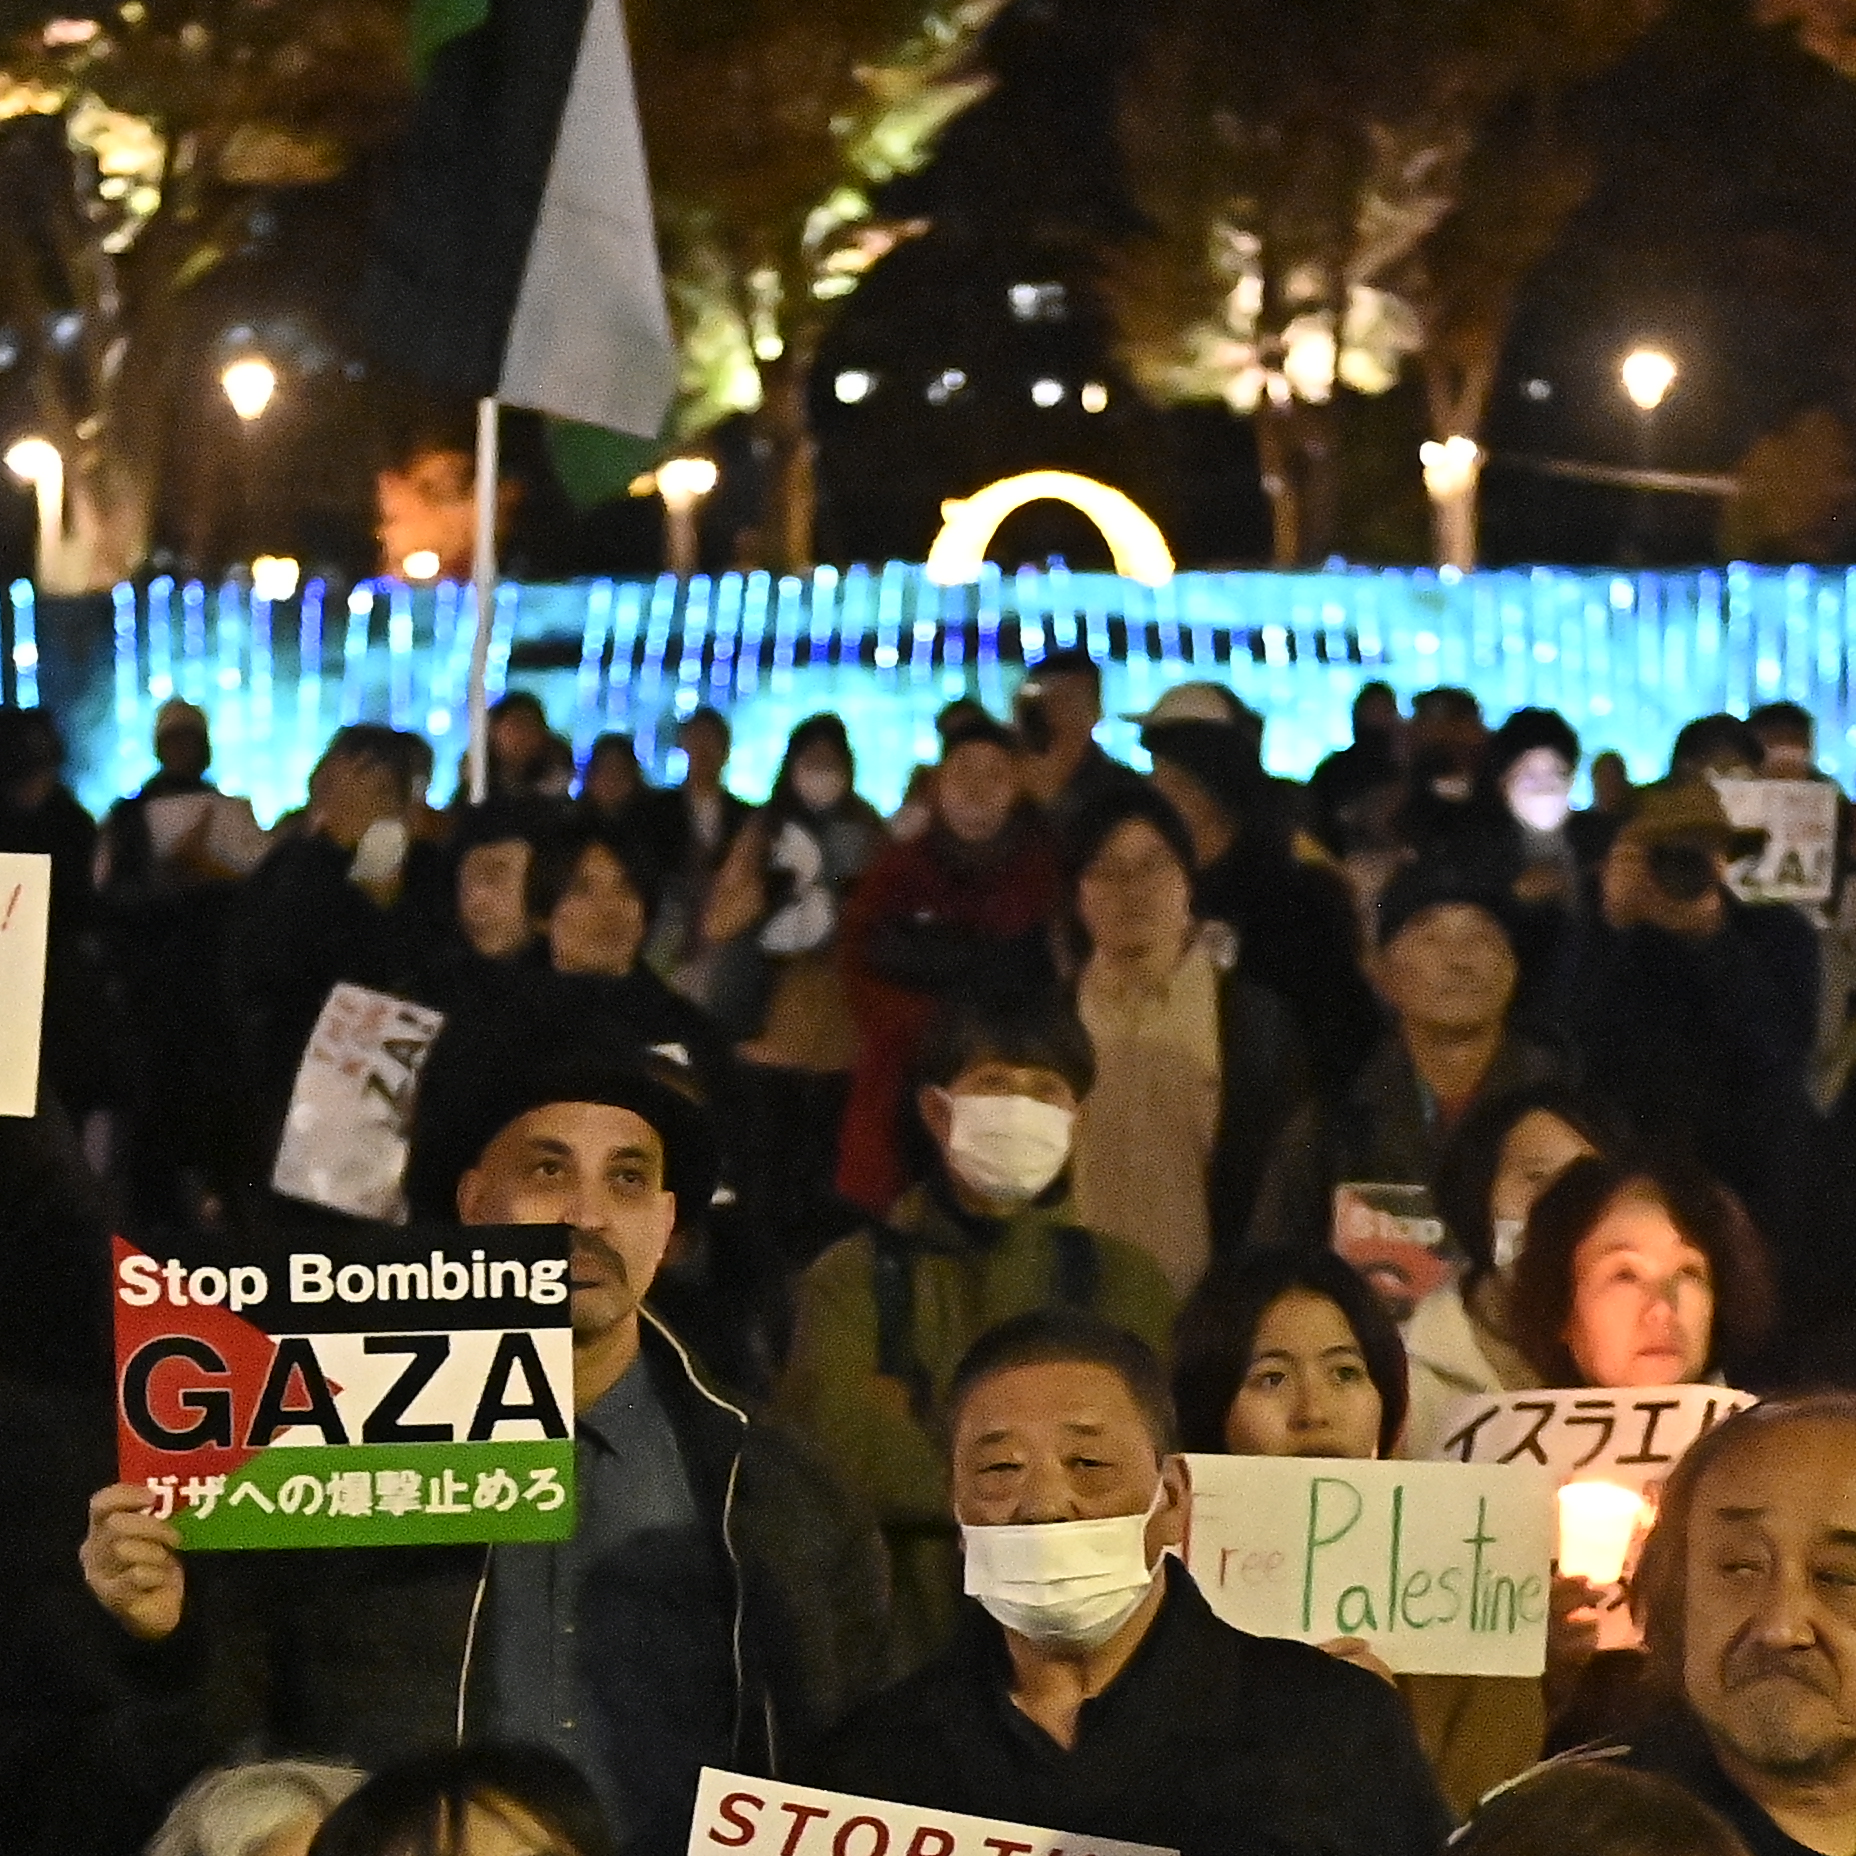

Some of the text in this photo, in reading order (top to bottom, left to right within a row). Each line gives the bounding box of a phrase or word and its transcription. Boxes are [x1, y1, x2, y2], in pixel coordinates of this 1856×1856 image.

[118, 1249, 570, 1312] Stop Bombing
[120, 1331, 571, 1453] GAZA
[140, 1466, 568, 1520] ガザへの爆撃止めろ
[1302, 1476, 1545, 1634] Palestine
